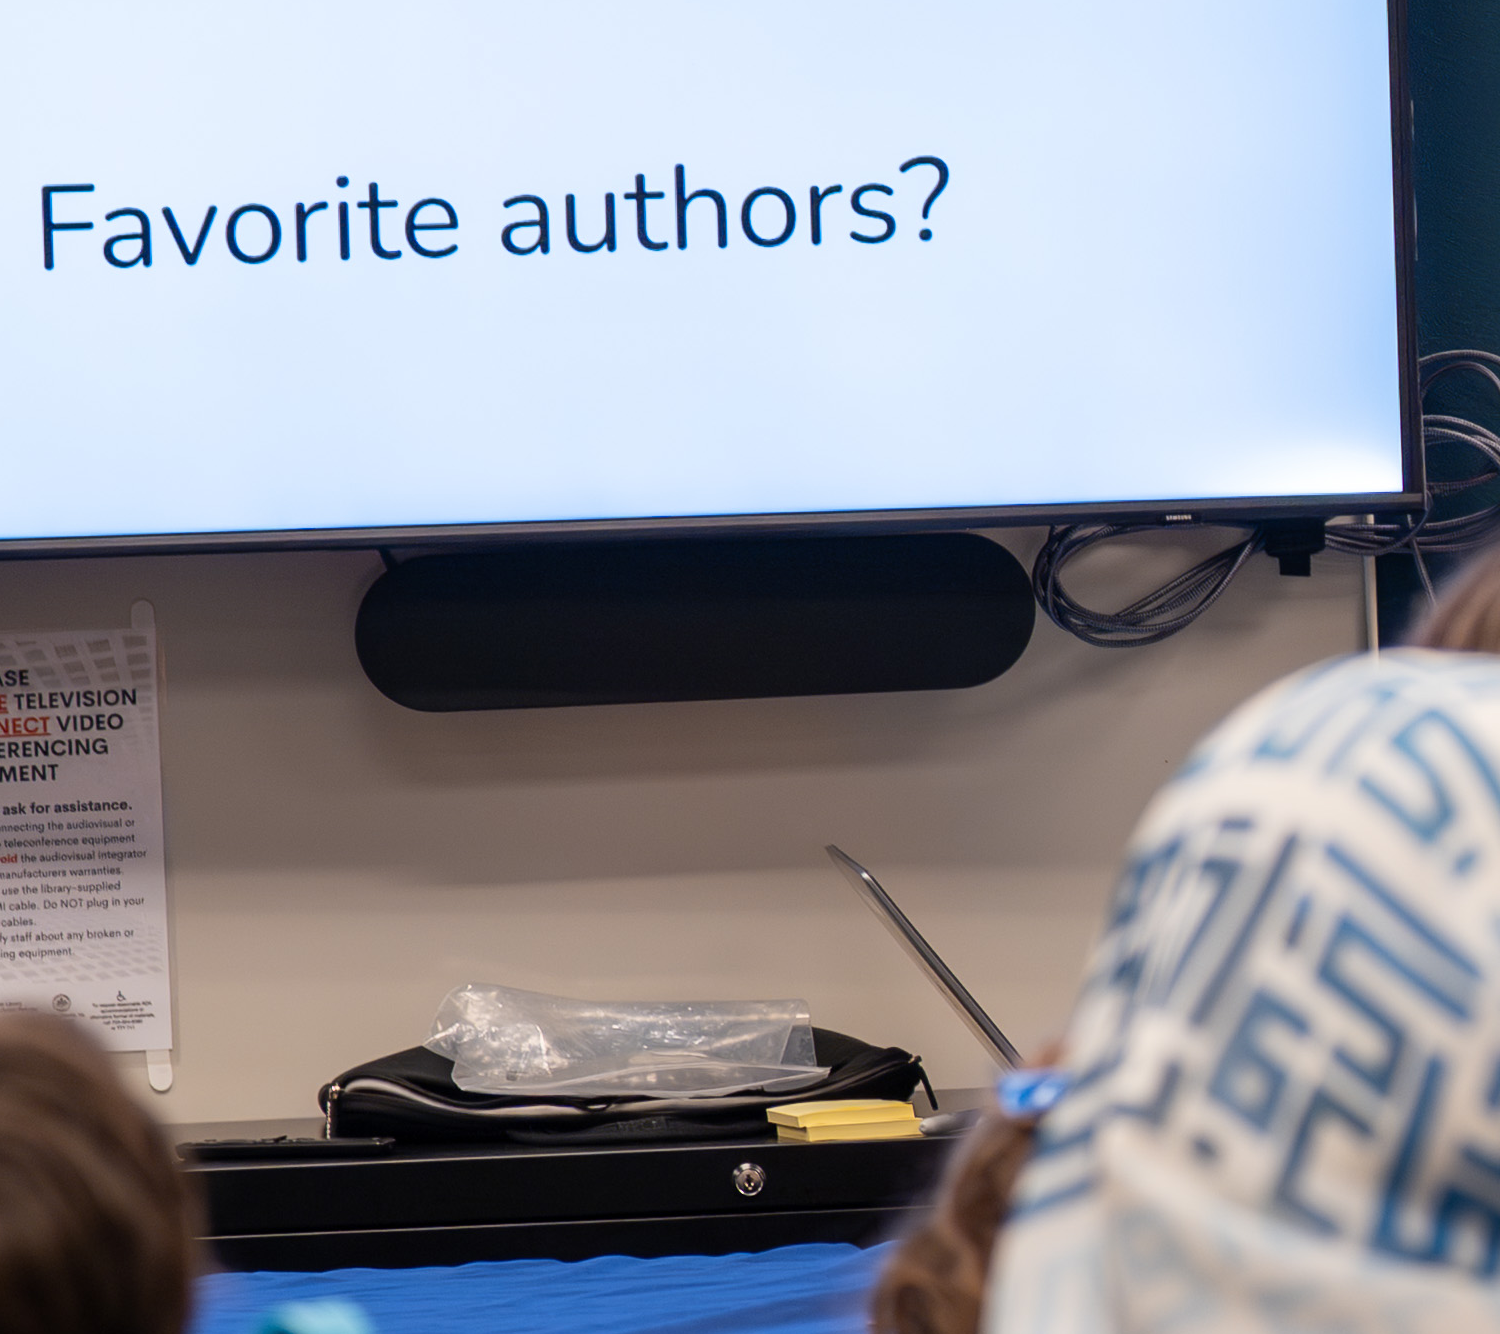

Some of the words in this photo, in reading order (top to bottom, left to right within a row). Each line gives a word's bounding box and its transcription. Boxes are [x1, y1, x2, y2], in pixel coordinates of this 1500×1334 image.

[41, 175, 459, 271] Favorite
[501, 155, 950, 256] authors?
[14, 689, 139, 712] TELEVISION
[57, 714, 125, 733] VIDEO
[2, 802, 27, 816] ask
[29, 801, 51, 814] for
[54, 800, 132, 813] assistance.
[47, 820, 64, 831] the
[66, 817, 122, 830] audiovisual
[124, 819, 135, 828] or
[3, 836, 79, 848] teleconference
[81, 834, 135, 848] equipment
[20, 853, 37, 863] the
[39, 850, 95, 863] audiovisual
[98, 849, 147, 862] integrator
[70, 865, 125, 878] warranties.
[1, 887, 20, 896] use
[21, 884, 38, 895] the
[8, 899, 40, 911] cable.
[43, 899, 58, 910] Do
[60, 897, 84, 909] NOT
[86, 897, 109, 910] plug
[111, 897, 121, 906] in
[123, 897, 145, 908] your
[0, 916, 37, 928] cables.
[10, 931, 32, 943] staff
[35, 931, 64, 942] about
[66, 932, 84, 942] any
[86, 929, 122, 939] broken
[123, 929, 134, 938] or
[18, 947, 75, 961] equipment.
